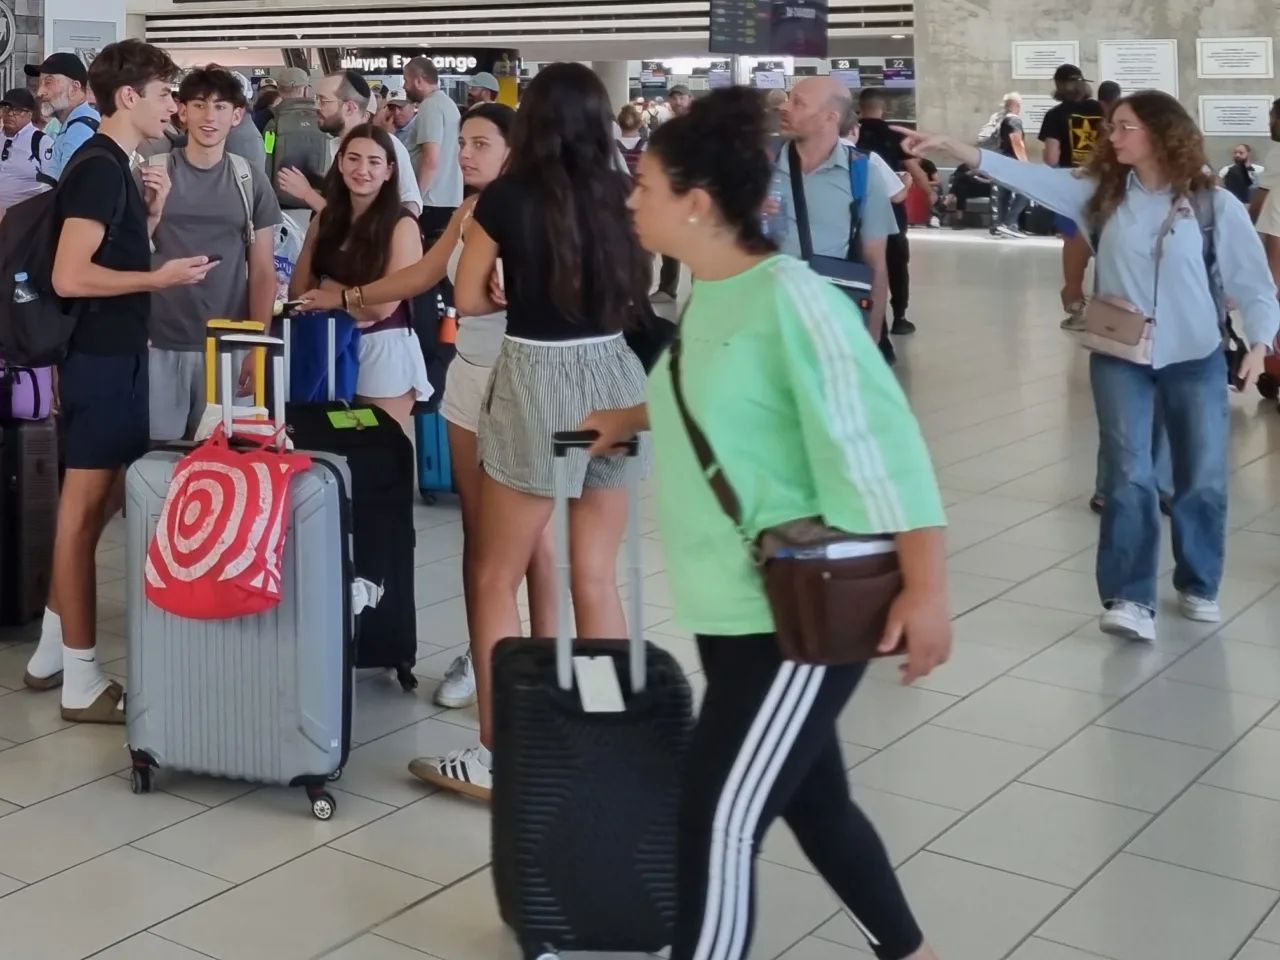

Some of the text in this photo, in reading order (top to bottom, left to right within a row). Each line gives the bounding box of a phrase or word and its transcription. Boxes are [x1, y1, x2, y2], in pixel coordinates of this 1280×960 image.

[393, 54, 477, 72] Exange
[838, 60, 850, 68] 23
[893, 60, 904, 68] 22
